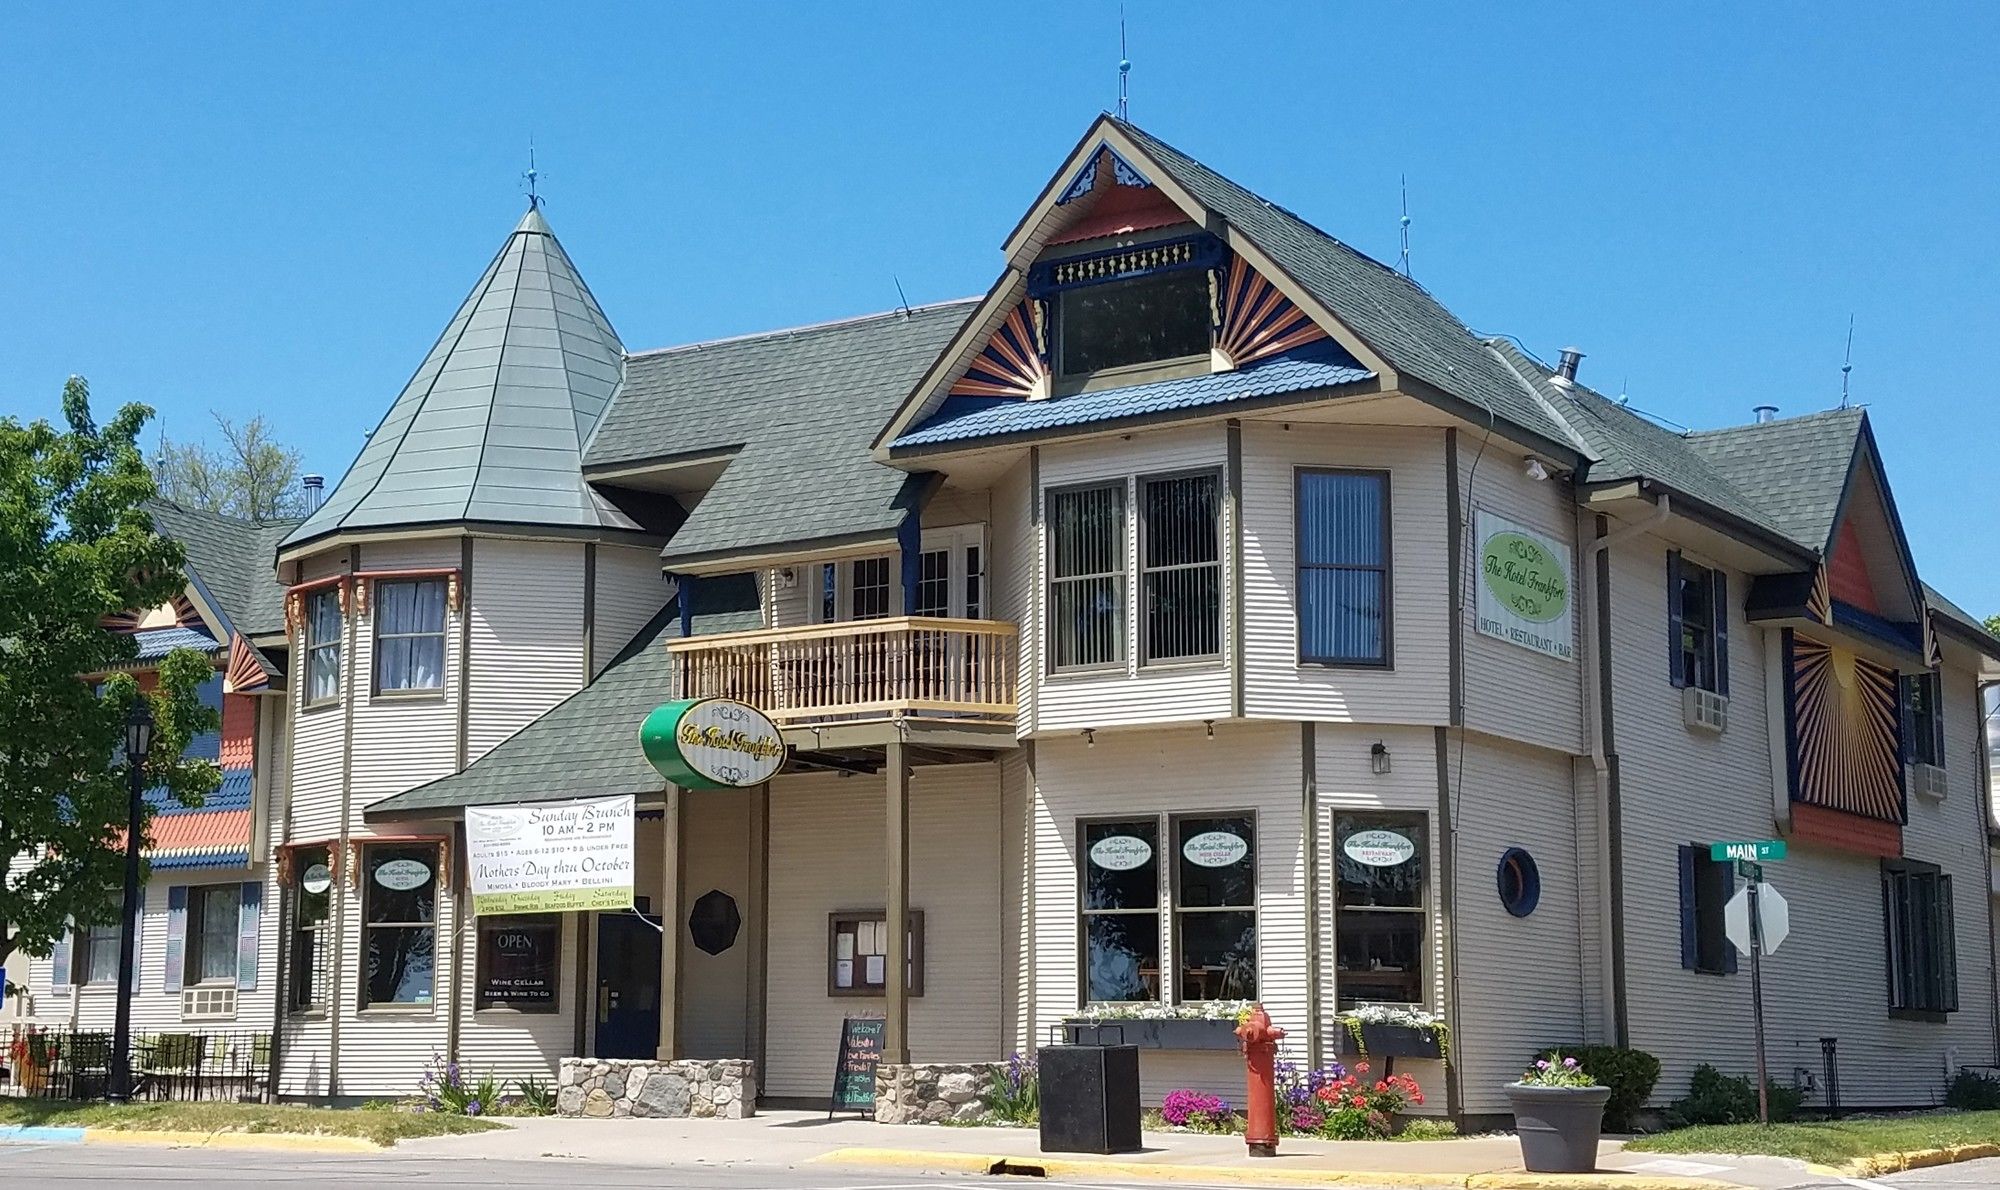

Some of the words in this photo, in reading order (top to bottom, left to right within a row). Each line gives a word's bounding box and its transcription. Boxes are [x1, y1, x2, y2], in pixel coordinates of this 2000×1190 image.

[1484, 554, 1501, 577] The
[1503, 561, 1527, 586] Hotel
[1527, 571, 1565, 601] Frankfort
[1480, 617, 1504, 637] HOTEL
[1510, 627, 1552, 653] RESTAURANT
[1558, 642, 1572, 658] BAR
[681, 723, 703, 746] The
[732, 731, 783, 761] Frankfort
[528, 808, 578, 826] Sunday
[582, 802, 630, 820] Brunch
[542, 825, 554, 835] 10
[558, 825, 575, 834] AM
[586, 822, 594, 833] 2
[599, 822, 615, 832] PM
[1726, 844, 1757, 858] MAIN
[1761, 846, 1769, 854] ST
[474, 863, 519, 880] Mothers
[522, 861, 550, 879] Day
[553, 859, 577, 874] thru
[581, 857, 630, 873] October
[553, 890, 576, 902] Friday
[593, 888, 628, 899] Saturday
[497, 934, 533, 949] OPEN
